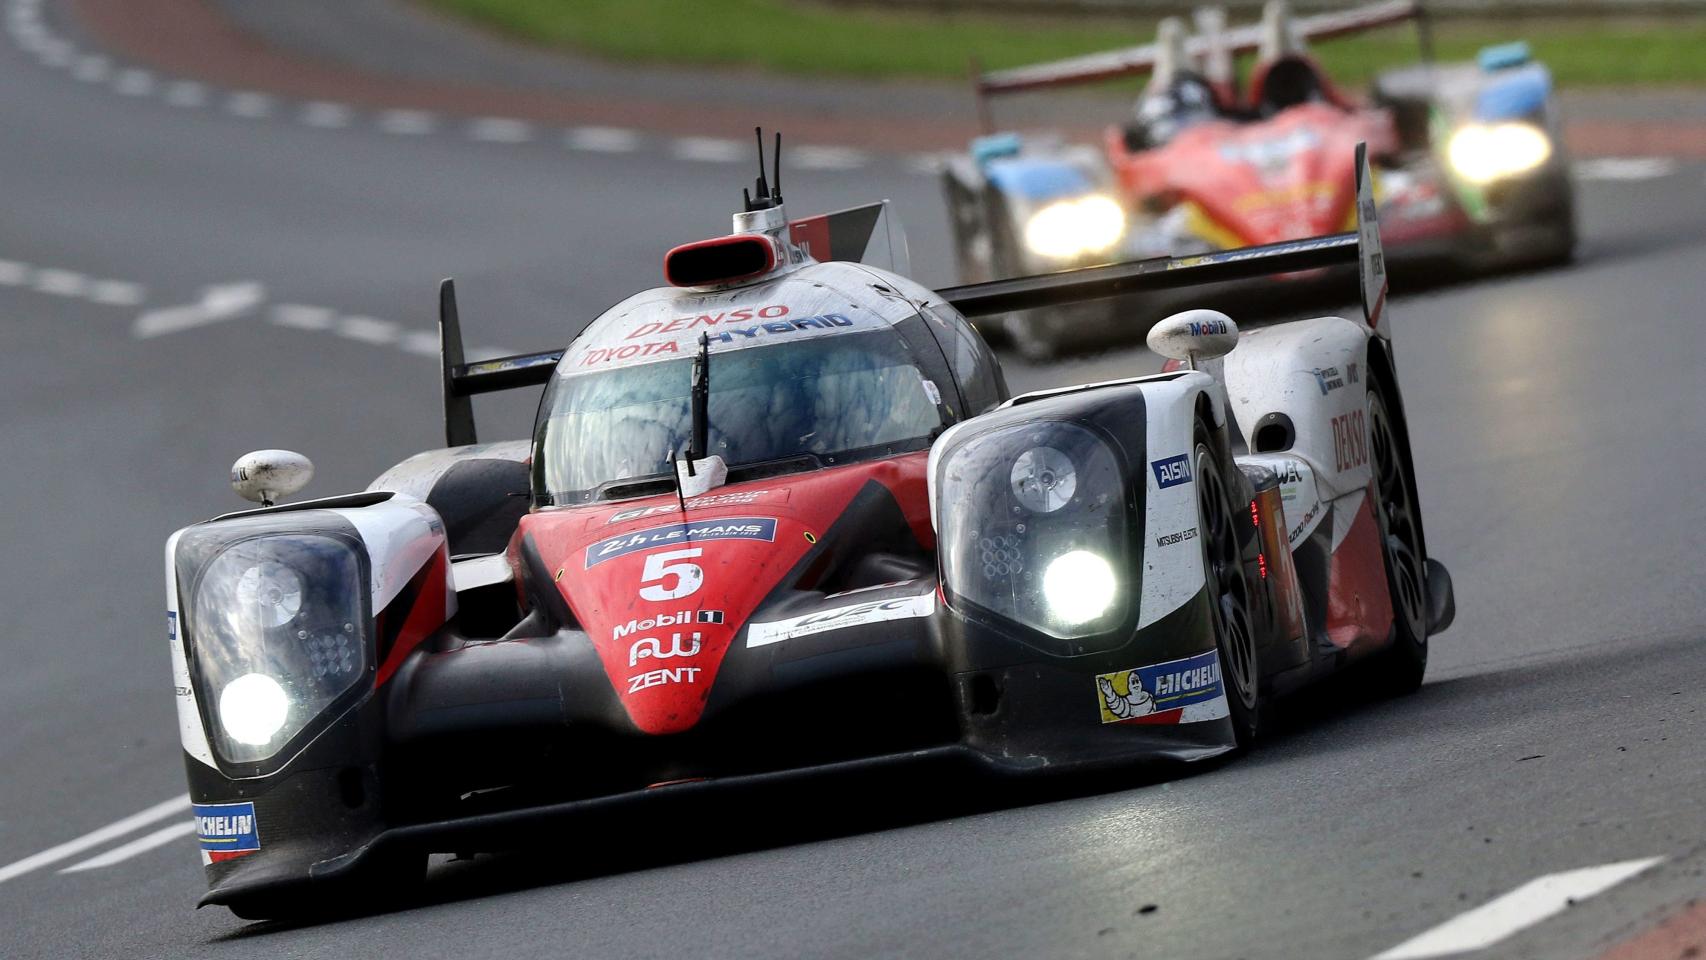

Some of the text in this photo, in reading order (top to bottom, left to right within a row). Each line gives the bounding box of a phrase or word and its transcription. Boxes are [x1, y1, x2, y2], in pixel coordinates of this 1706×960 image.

[624, 304, 790, 341] DENSO
[1190, 321, 1219, 337] Mobil
[579, 339, 679, 367] TOYOTA
[703, 312, 854, 343] HYBRID
[1330, 409, 1368, 473] DENSO
[1159, 459, 1190, 483] AISIN
[651, 530, 684, 541] LE
[686, 525, 763, 536] MANS
[639, 547, 704, 602] 5
[613, 610, 691, 641] Mobil
[628, 667, 702, 694] ZENT
[1155, 662, 1221, 696] MICHELIN
